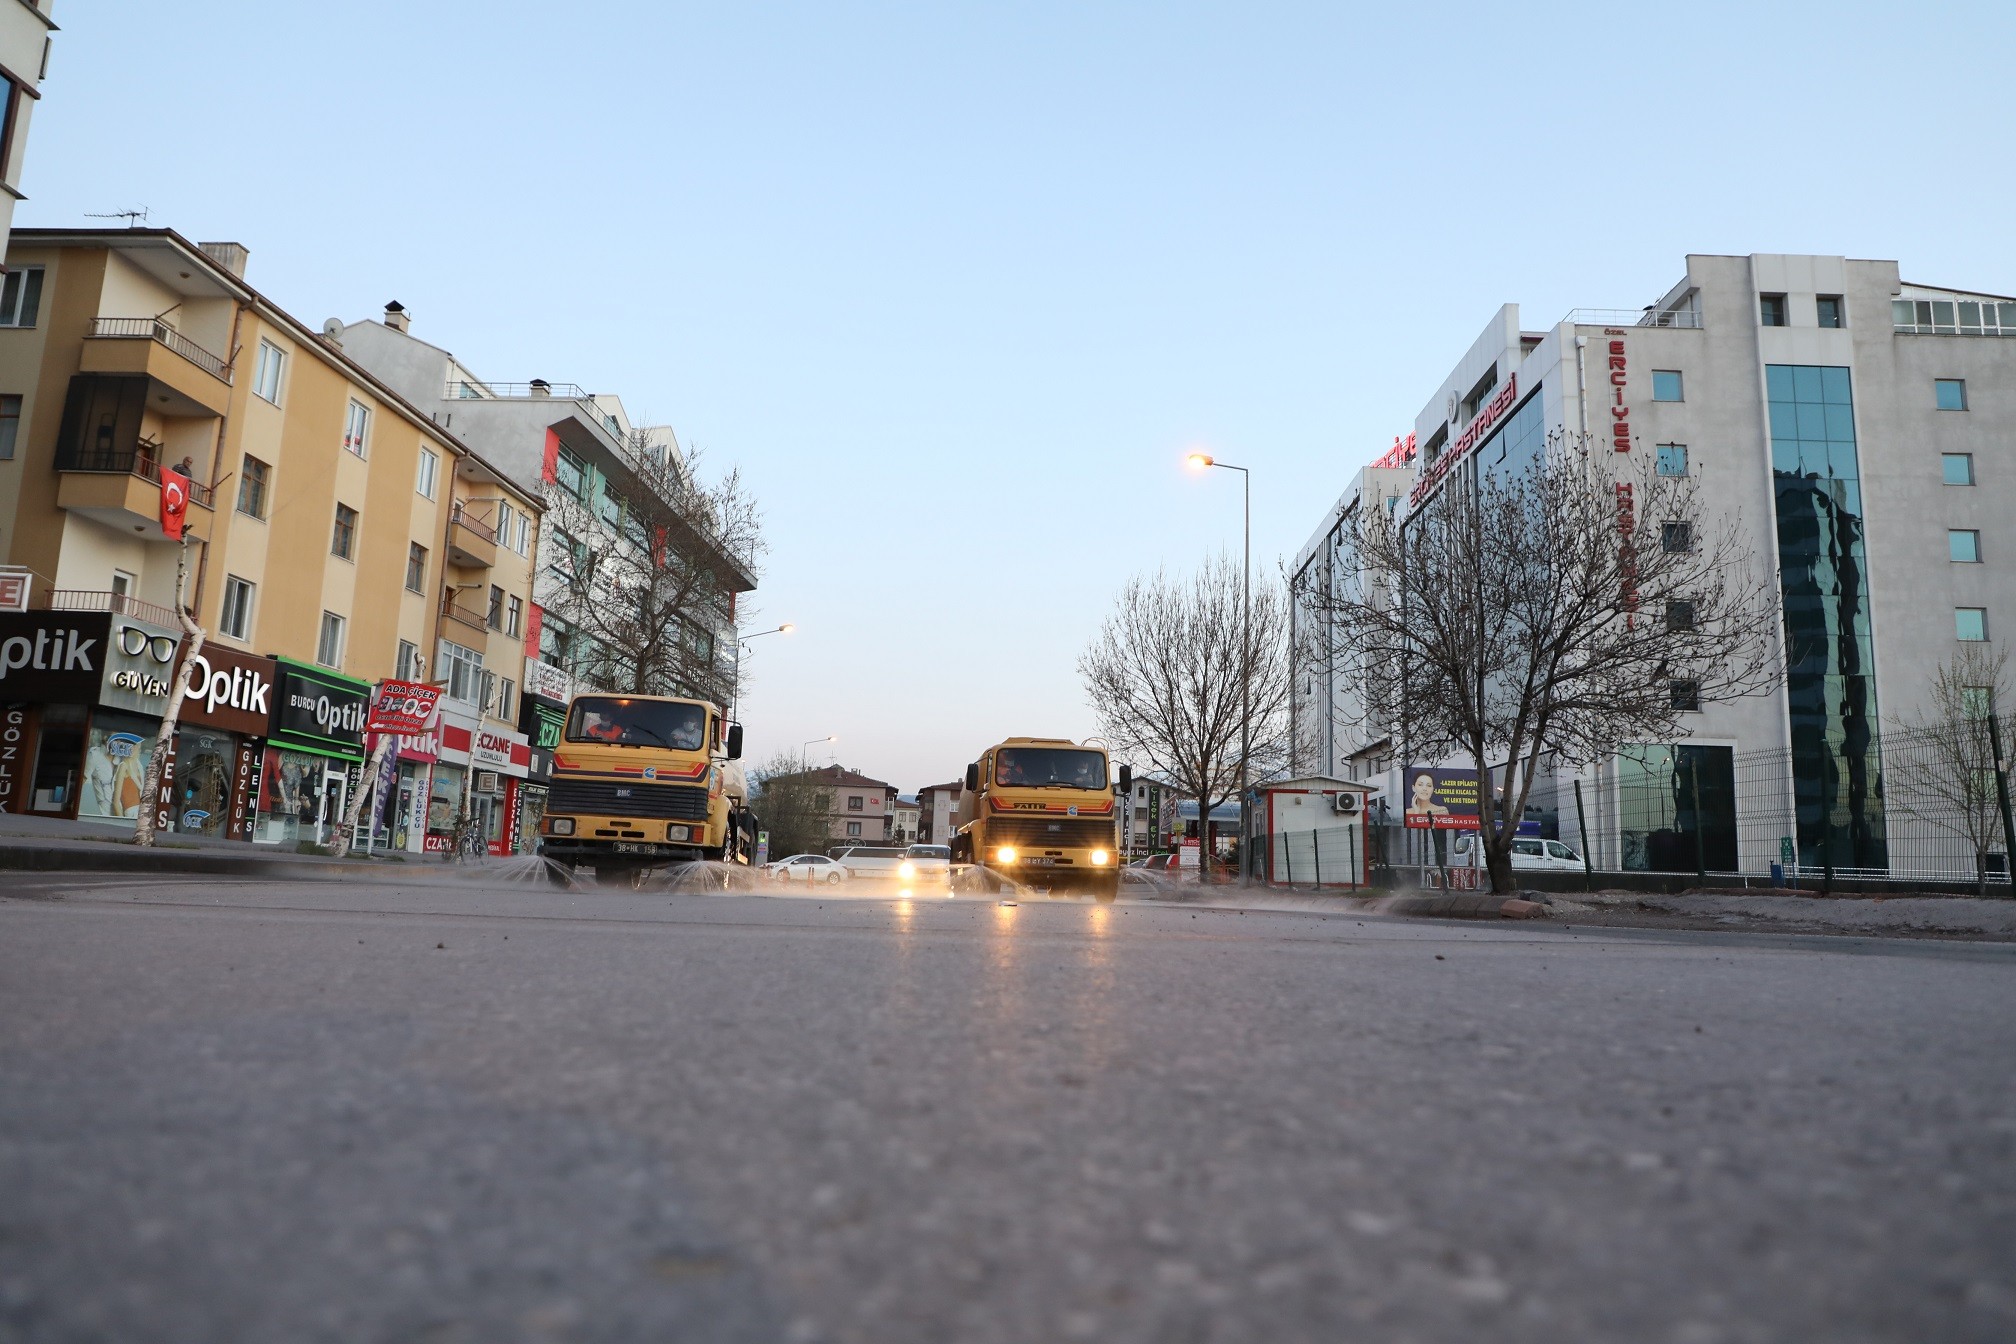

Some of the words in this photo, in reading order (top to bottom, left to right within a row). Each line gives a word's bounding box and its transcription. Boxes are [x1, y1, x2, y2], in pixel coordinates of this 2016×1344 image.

[1608, 340, 1631, 454] ERCİYES
[111, 670, 169, 698] GÜVEN
[185, 654, 271, 715] Optik
[290, 694, 316, 711] BURCU
[316, 695, 366, 735] Optik
[385, 684, 407, 695] ADA
[407, 685, 437, 700] ÇİÇEK
[158, 734, 177, 828] LENS
[232, 751, 250, 833] GÖZLÜK
[246, 755, 262, 832] LENS
[508, 788, 518, 851] ECZANE
[514, 790, 522, 843] ECZANE
